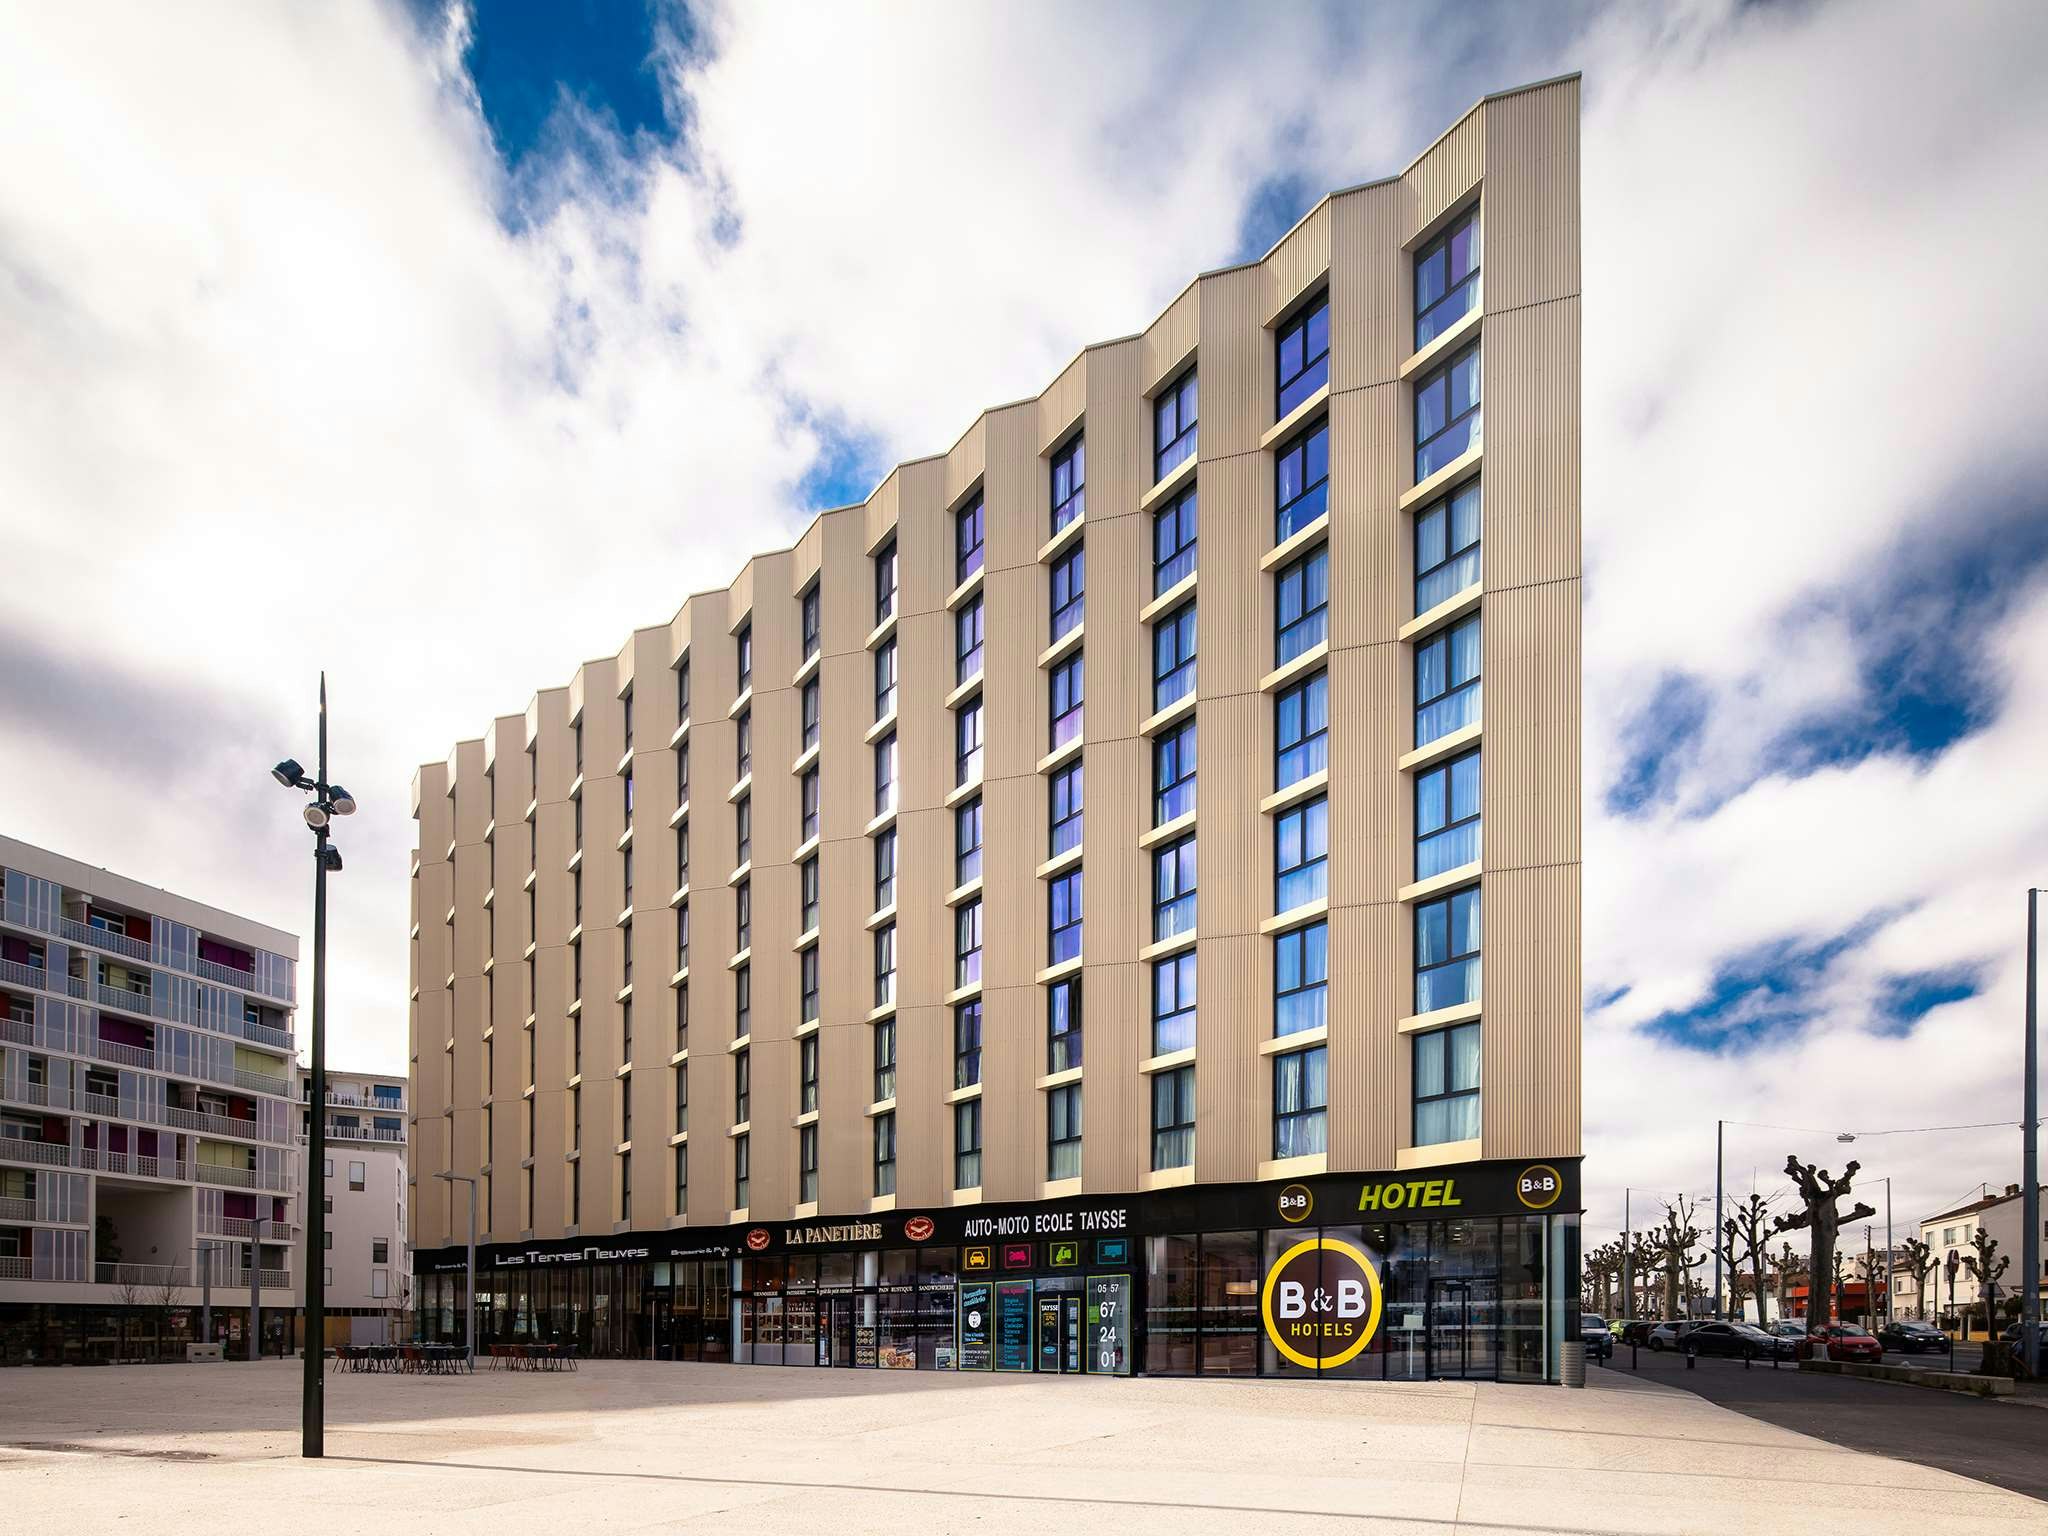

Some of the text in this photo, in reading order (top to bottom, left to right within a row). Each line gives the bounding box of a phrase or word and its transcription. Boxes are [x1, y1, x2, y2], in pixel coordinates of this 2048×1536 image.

[1521, 1177, 1555, 1193] B&B
[1279, 1194, 1307, 1209] B&B
[1358, 1179, 1462, 1211] HOTEL
[785, 1228, 804, 1245] LA
[805, 1219, 883, 1244] PANETIÈRE
[964, 1209, 1127, 1238] AUTO-MOTO ECOLE TAYSSE
[495, 1247, 649, 1266] Les Terres Neuves
[1097, 1284, 1119, 1293] 05 57
[1279, 1279, 1366, 1319] B&B
[1100, 1301, 1116, 1318] 67
[1100, 1326, 1117, 1343] 24
[1290, 1323, 1353, 1337] HOTELS
[1100, 1351, 1116, 1368] 01
